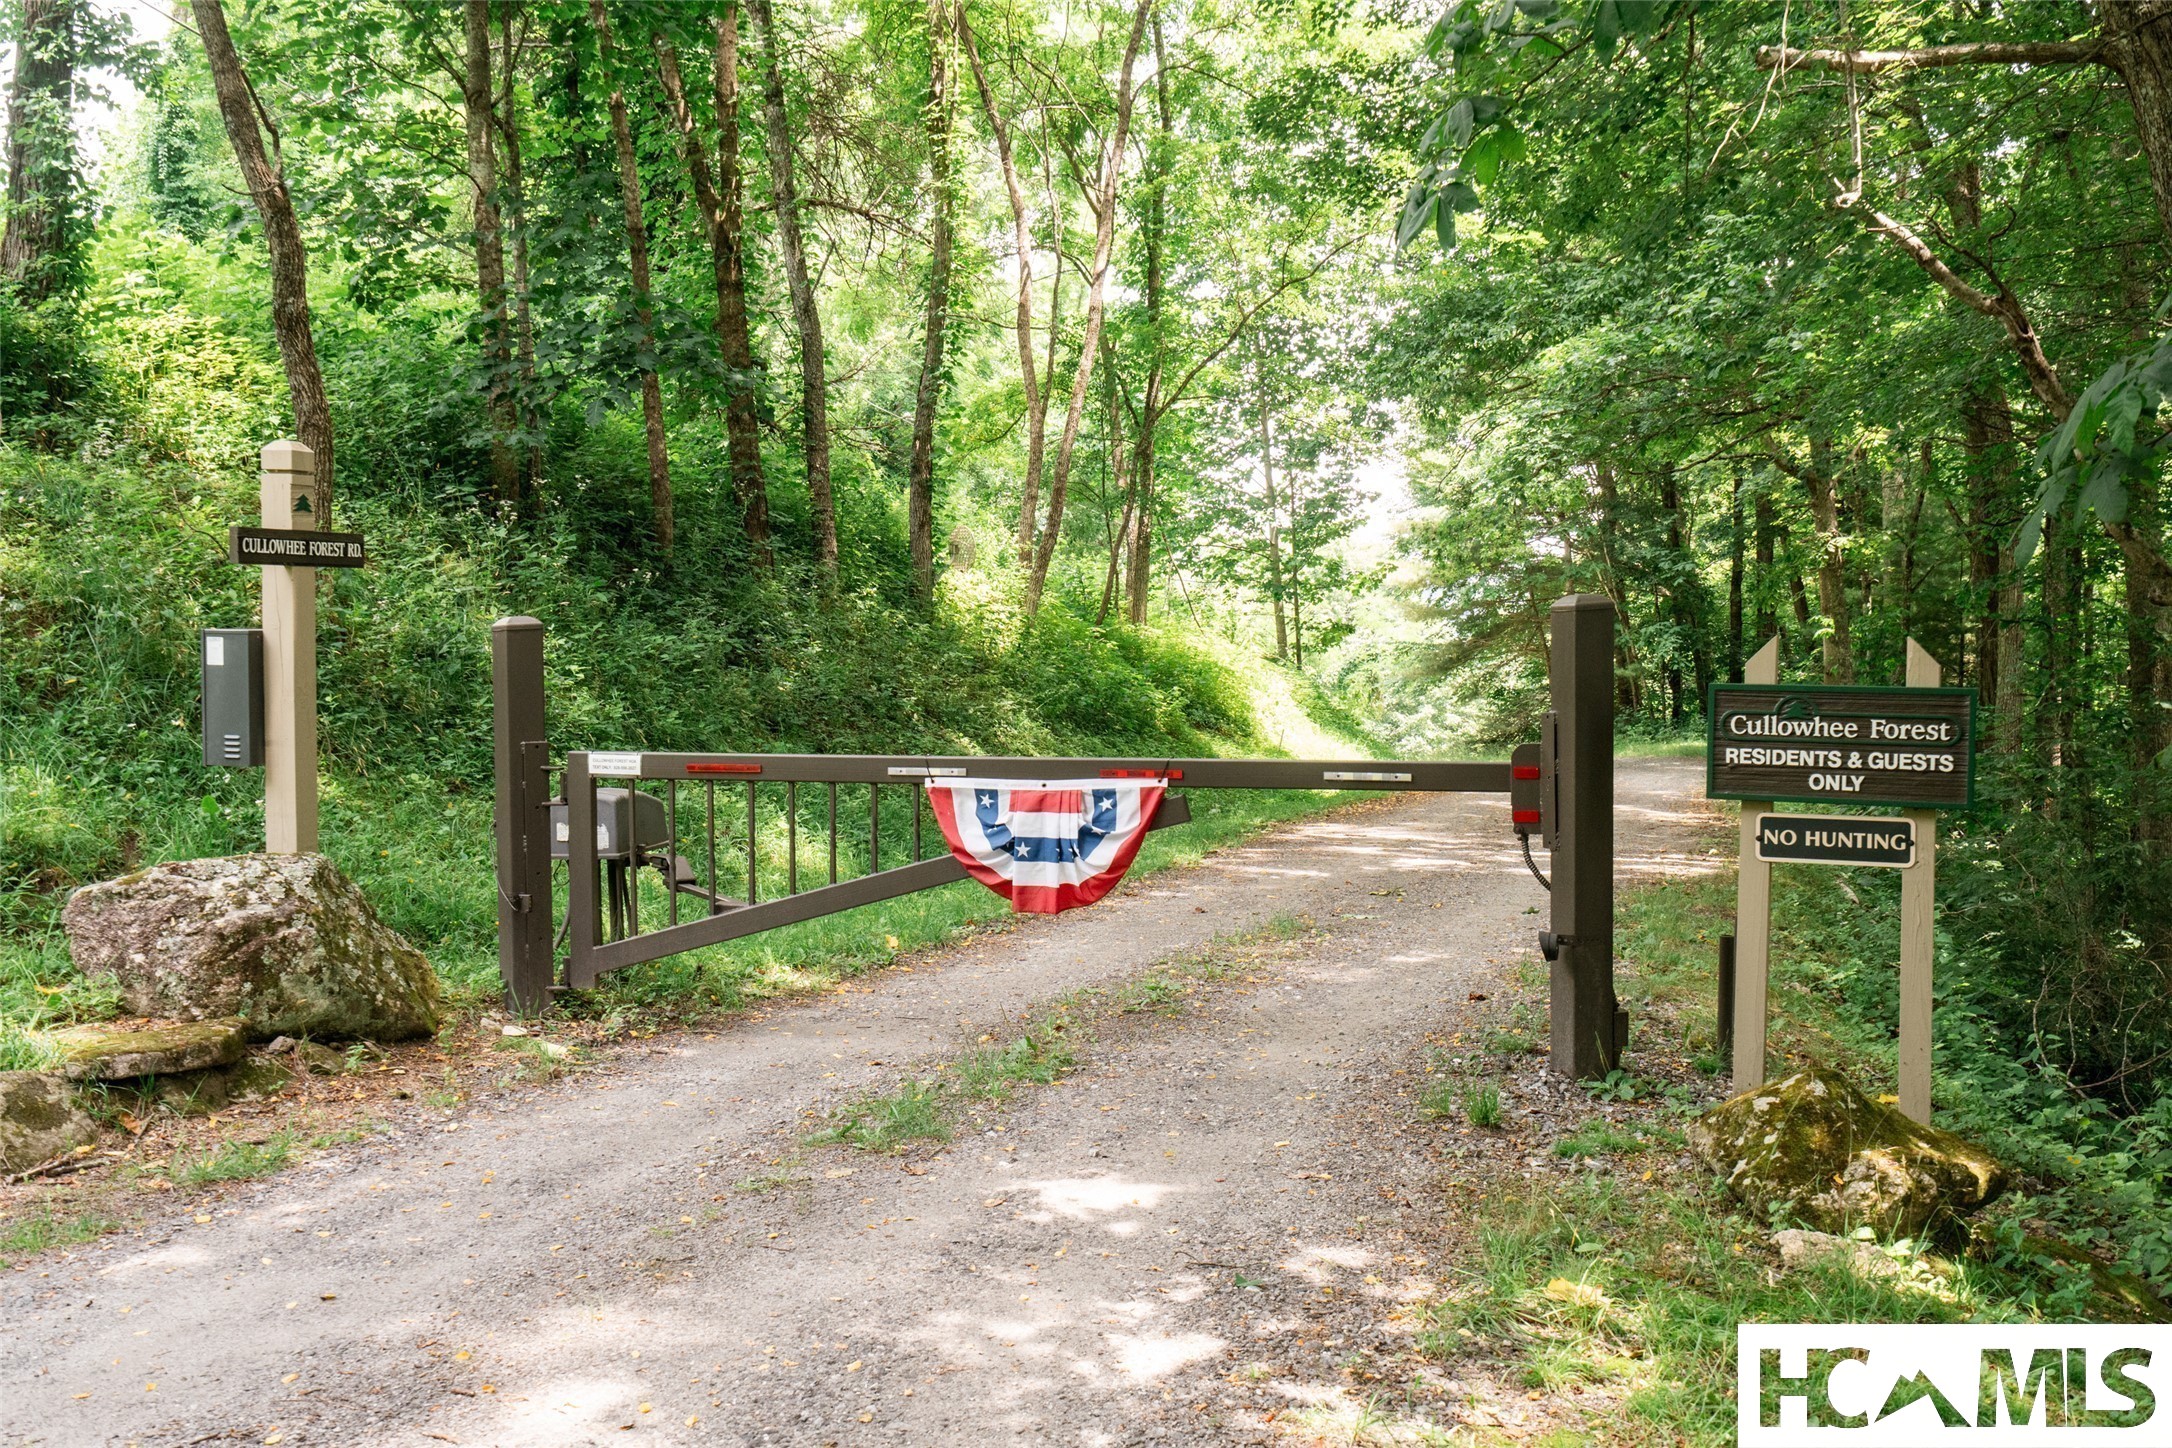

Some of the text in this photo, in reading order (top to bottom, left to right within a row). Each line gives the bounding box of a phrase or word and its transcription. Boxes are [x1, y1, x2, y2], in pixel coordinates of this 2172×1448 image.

[242, 537, 362, 558] CULLOWHEE FOREST RD.
[1730, 714, 1951, 742] Cullowhee Forest
[1725, 747, 1955, 773] RESIDENTS & GUESTS
[1808, 773, 1865, 792] ONLY
[1763, 828, 1906, 850] NO HUNTING
